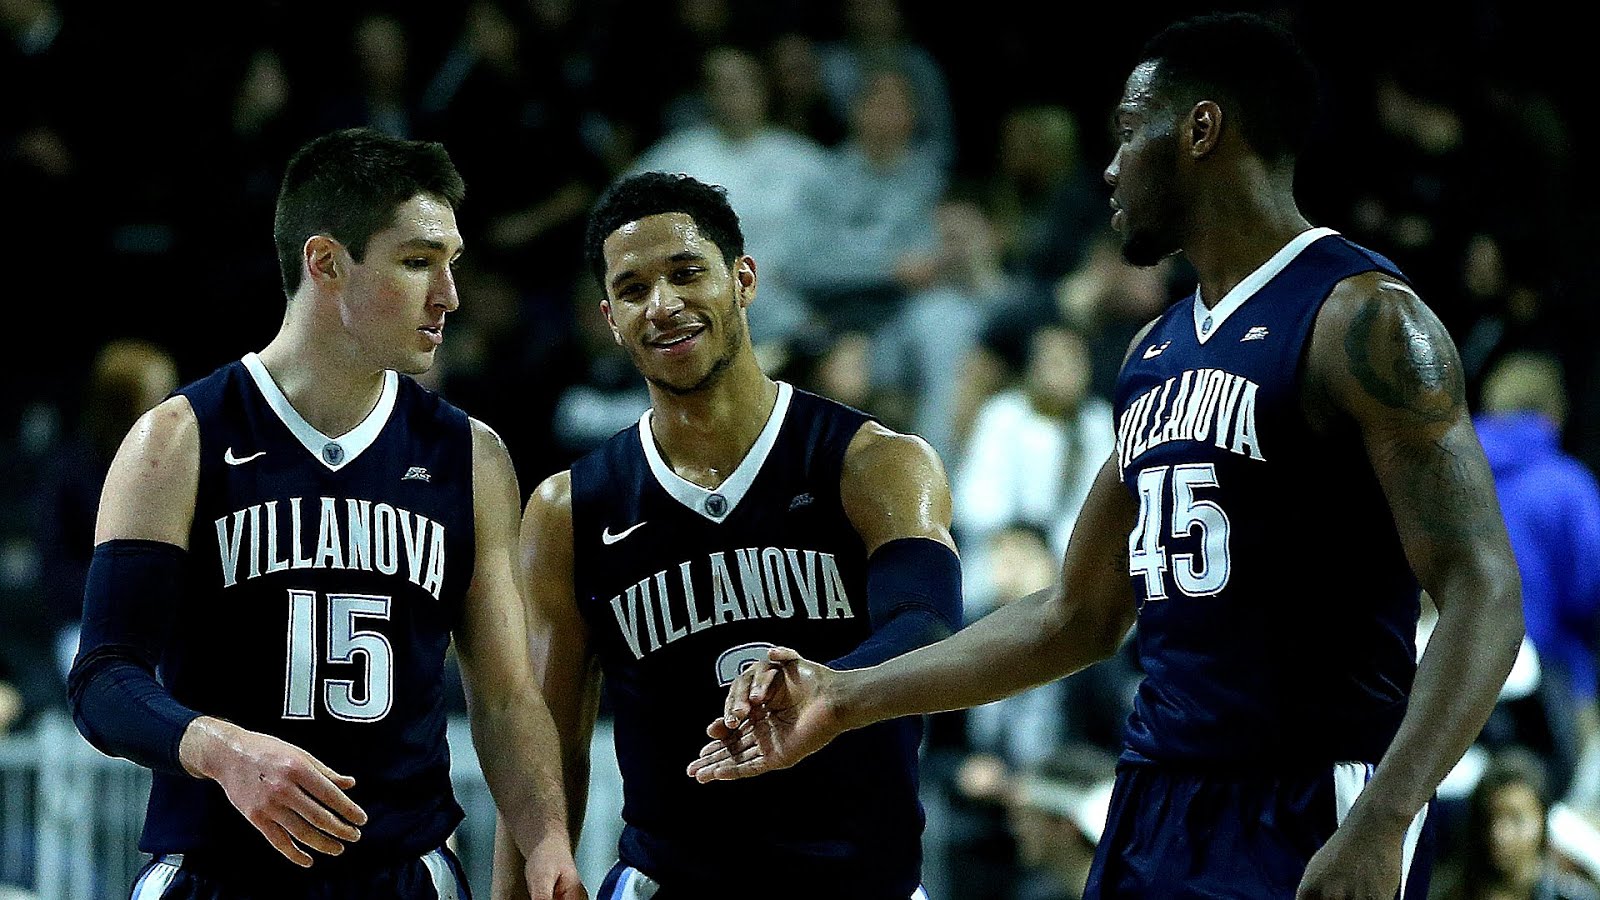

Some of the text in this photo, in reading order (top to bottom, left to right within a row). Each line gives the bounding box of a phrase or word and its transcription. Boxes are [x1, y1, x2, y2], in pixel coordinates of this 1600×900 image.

[1116, 368, 1267, 482] VILLANOVA
[214, 497, 445, 600] VILLANOVA
[1128, 463, 1231, 600] 45
[281, 588, 394, 723] 15
[609, 547, 855, 660] VILLANOVA
